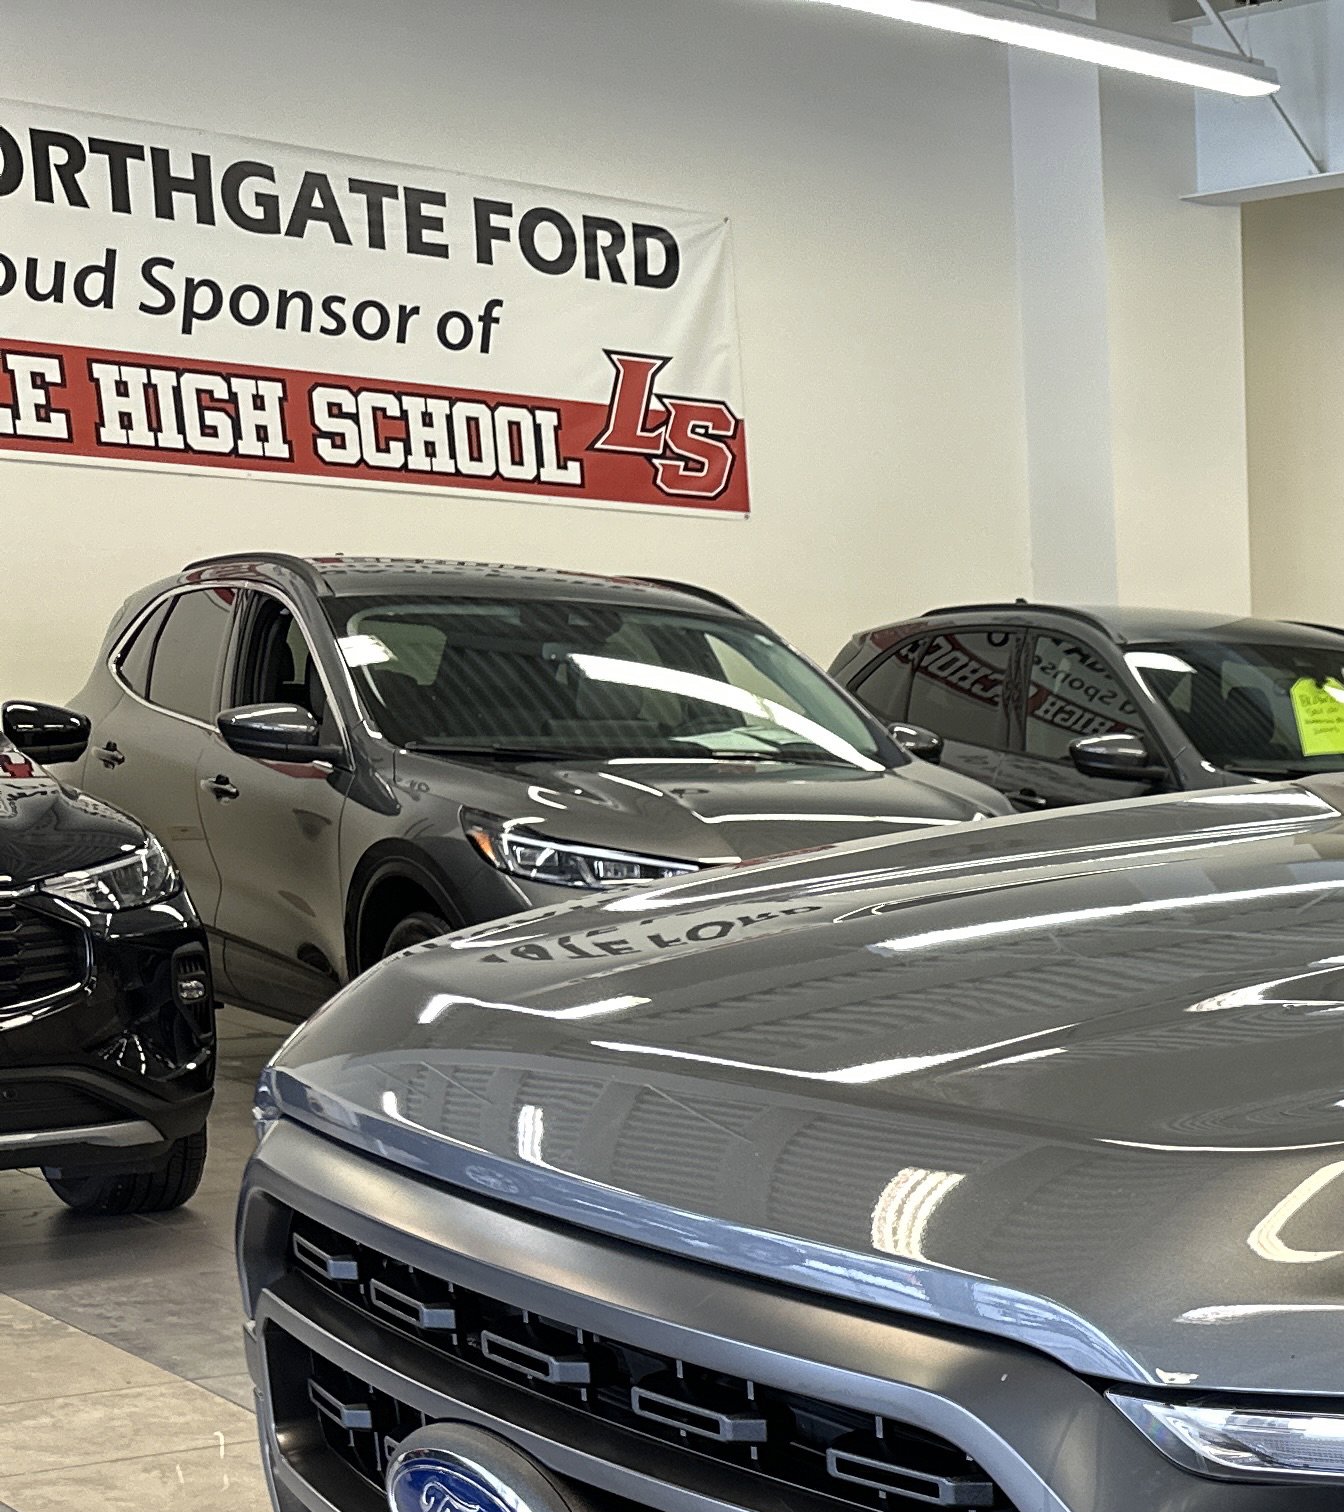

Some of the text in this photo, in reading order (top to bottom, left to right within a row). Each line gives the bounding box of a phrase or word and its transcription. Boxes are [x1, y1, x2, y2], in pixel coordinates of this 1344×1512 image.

[474, 197, 680, 289] FORD
[139, 257, 420, 345] Sponsor
[437, 299, 503, 354] of
[88, 358, 294, 460] HIGH
[308, 383, 584, 487] SCHOOL
[586, 348, 737, 499] LS
